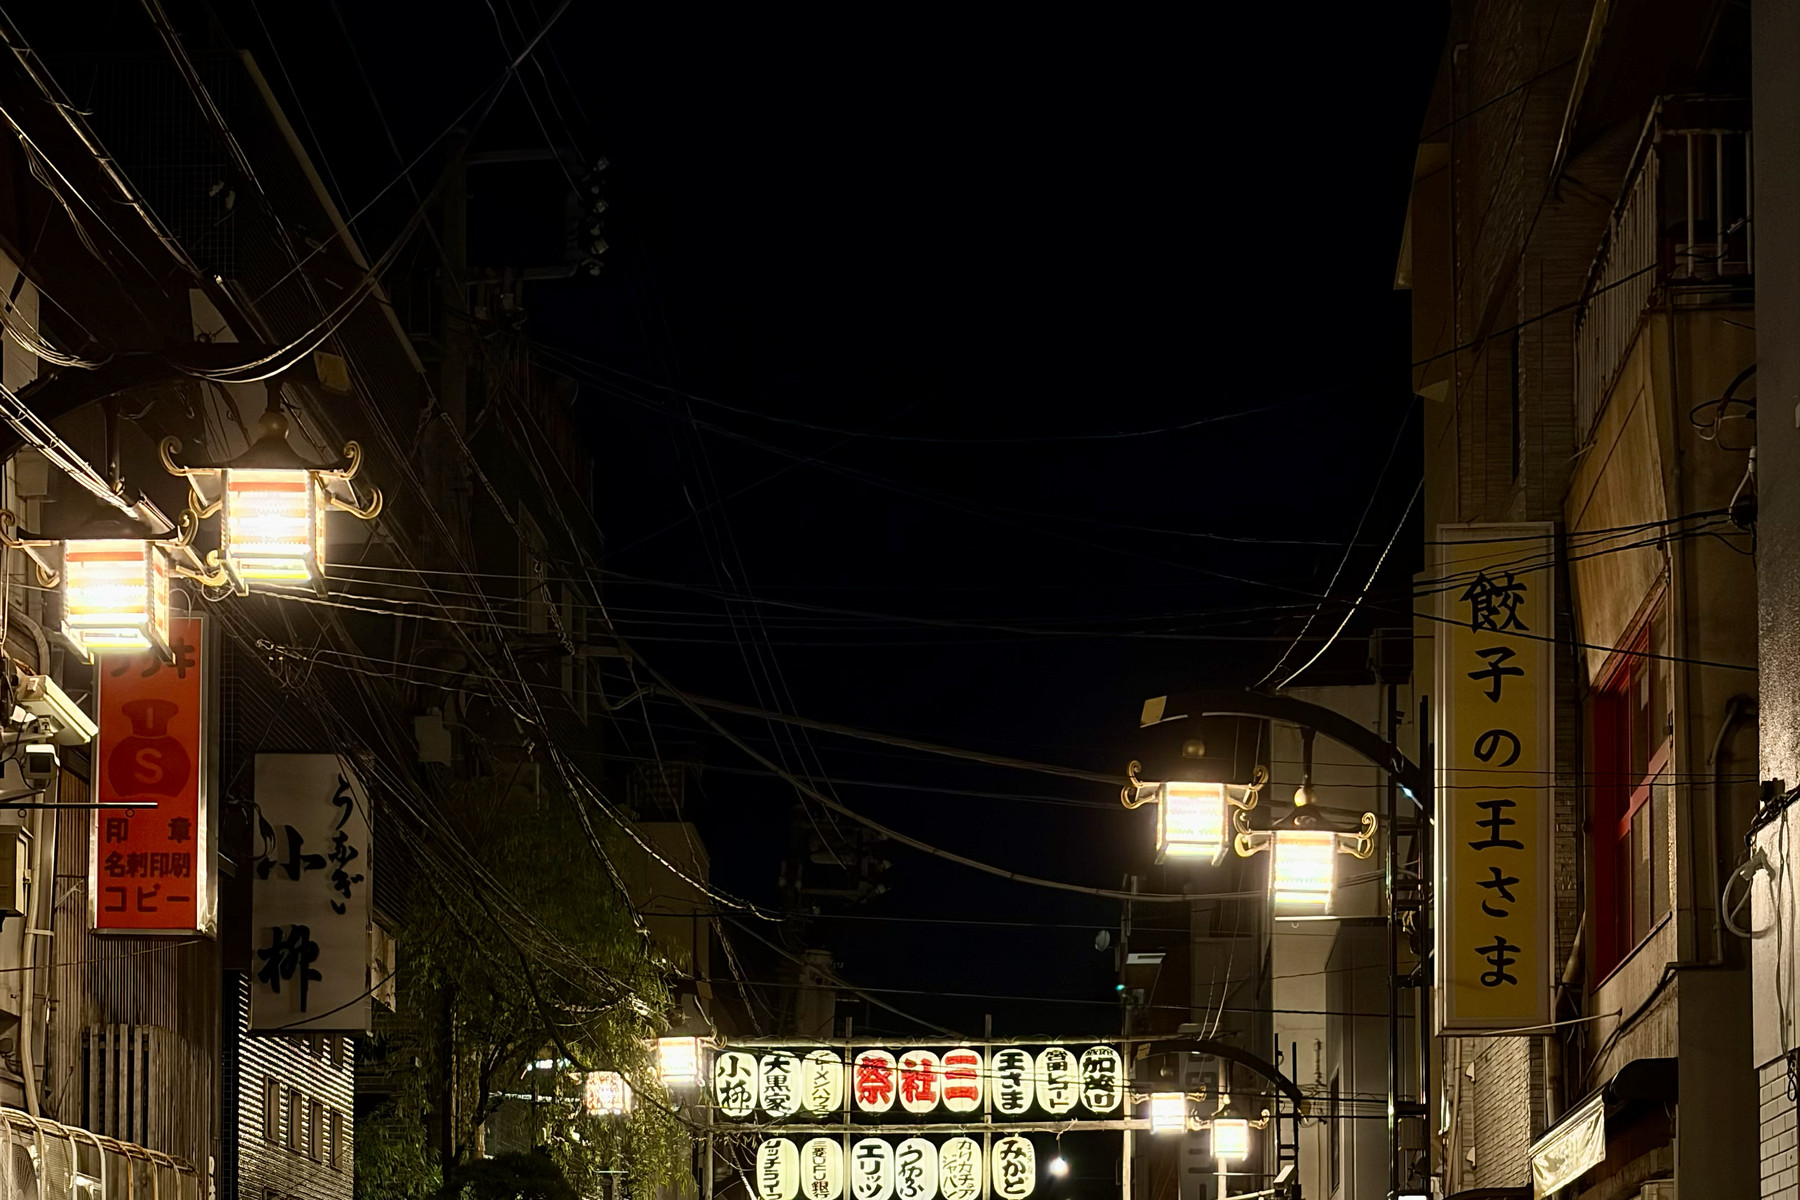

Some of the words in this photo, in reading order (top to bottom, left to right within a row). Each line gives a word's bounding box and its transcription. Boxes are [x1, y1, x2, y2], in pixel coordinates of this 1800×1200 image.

[134, 748, 163, 784] S
[1459, 571, 1531, 988] 餃子の王さま
[106, 817, 191, 843] 印章
[104, 852, 191, 878] 名刺印刷
[105, 883, 190, 913] コピー
[256, 824, 326, 1013] 小柳
[718, 1055, 752, 1113] 小柳
[764, 1054, 791, 1110] 大黒家
[998, 1052, 1025, 1110] 王さま
[763, 1140, 783, 1200] リッチライフ
[943, 1154, 957, 1198] ジャパン
[958, 1140, 975, 1198] カリカチュア
